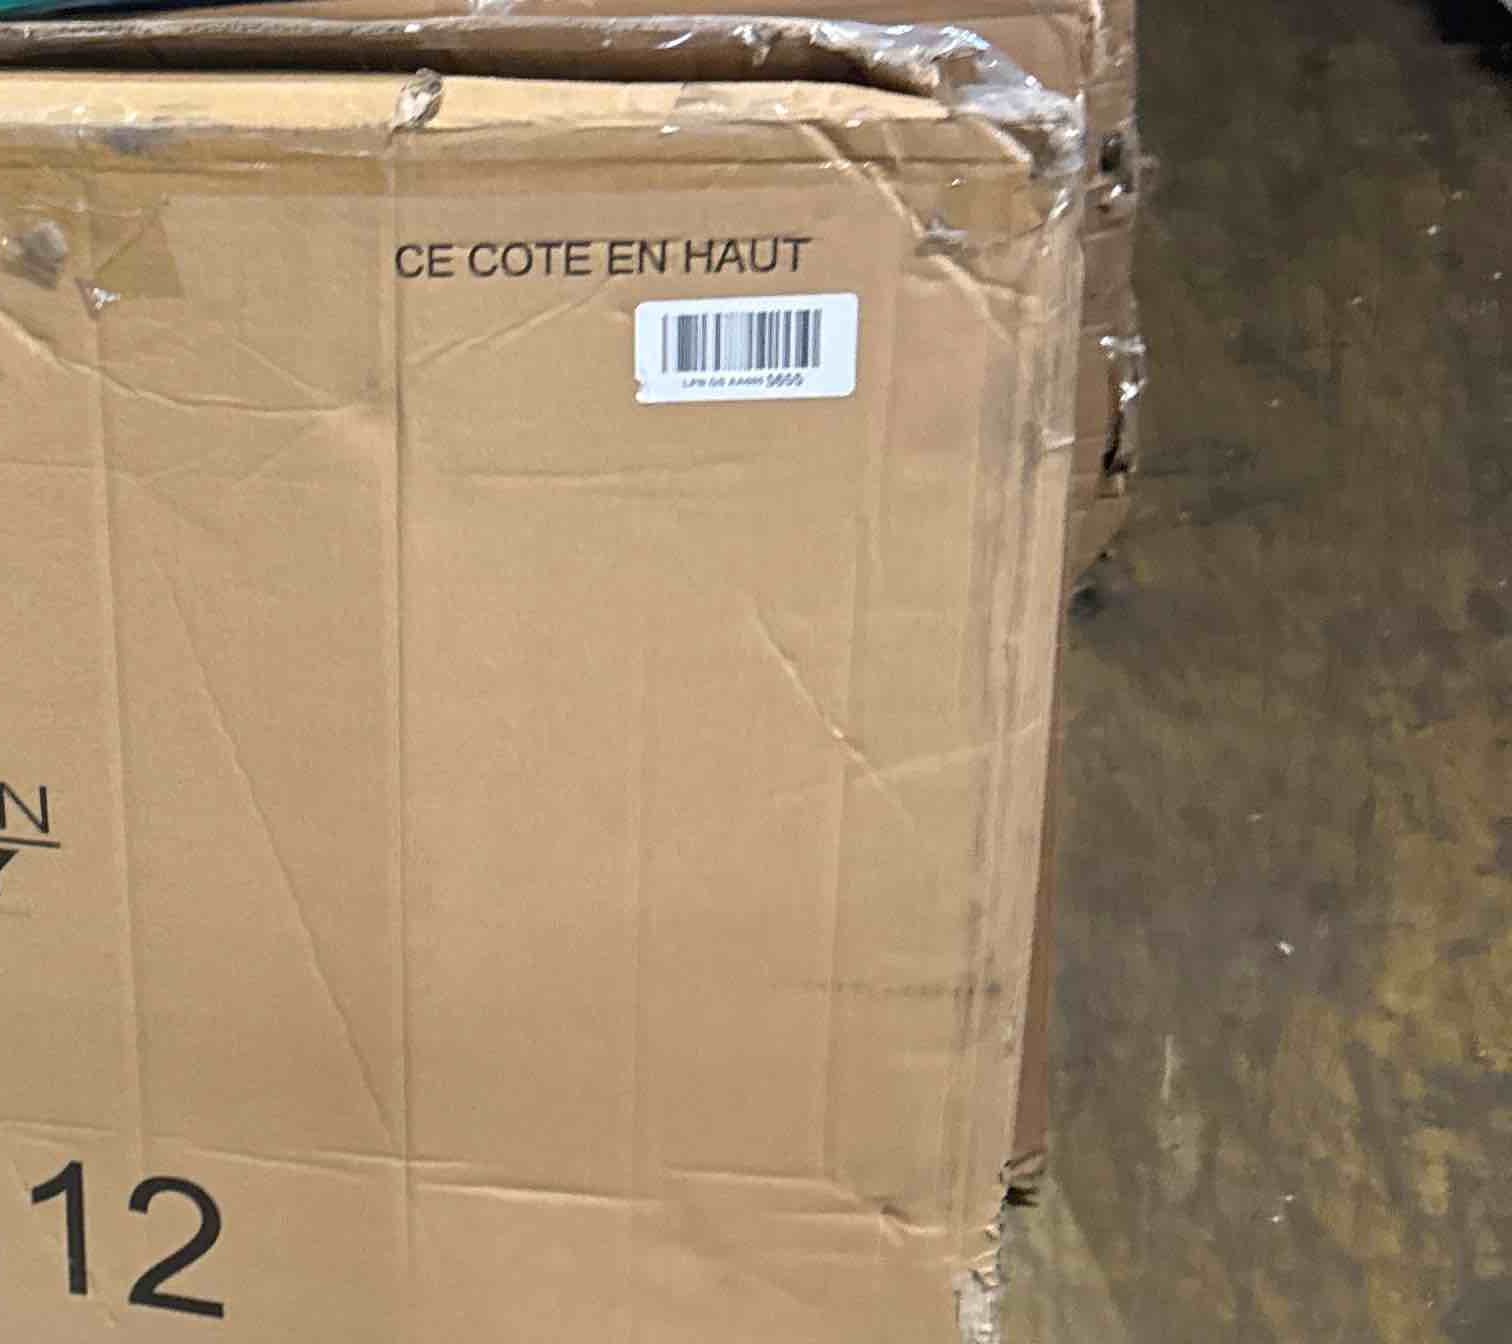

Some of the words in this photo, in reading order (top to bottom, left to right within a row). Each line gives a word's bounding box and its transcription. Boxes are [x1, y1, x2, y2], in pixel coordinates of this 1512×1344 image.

[393, 242, 455, 279] CE
[468, 239, 593, 278] COTE
[606, 238, 669, 275] EN
[683, 236, 813, 274] HAUT
